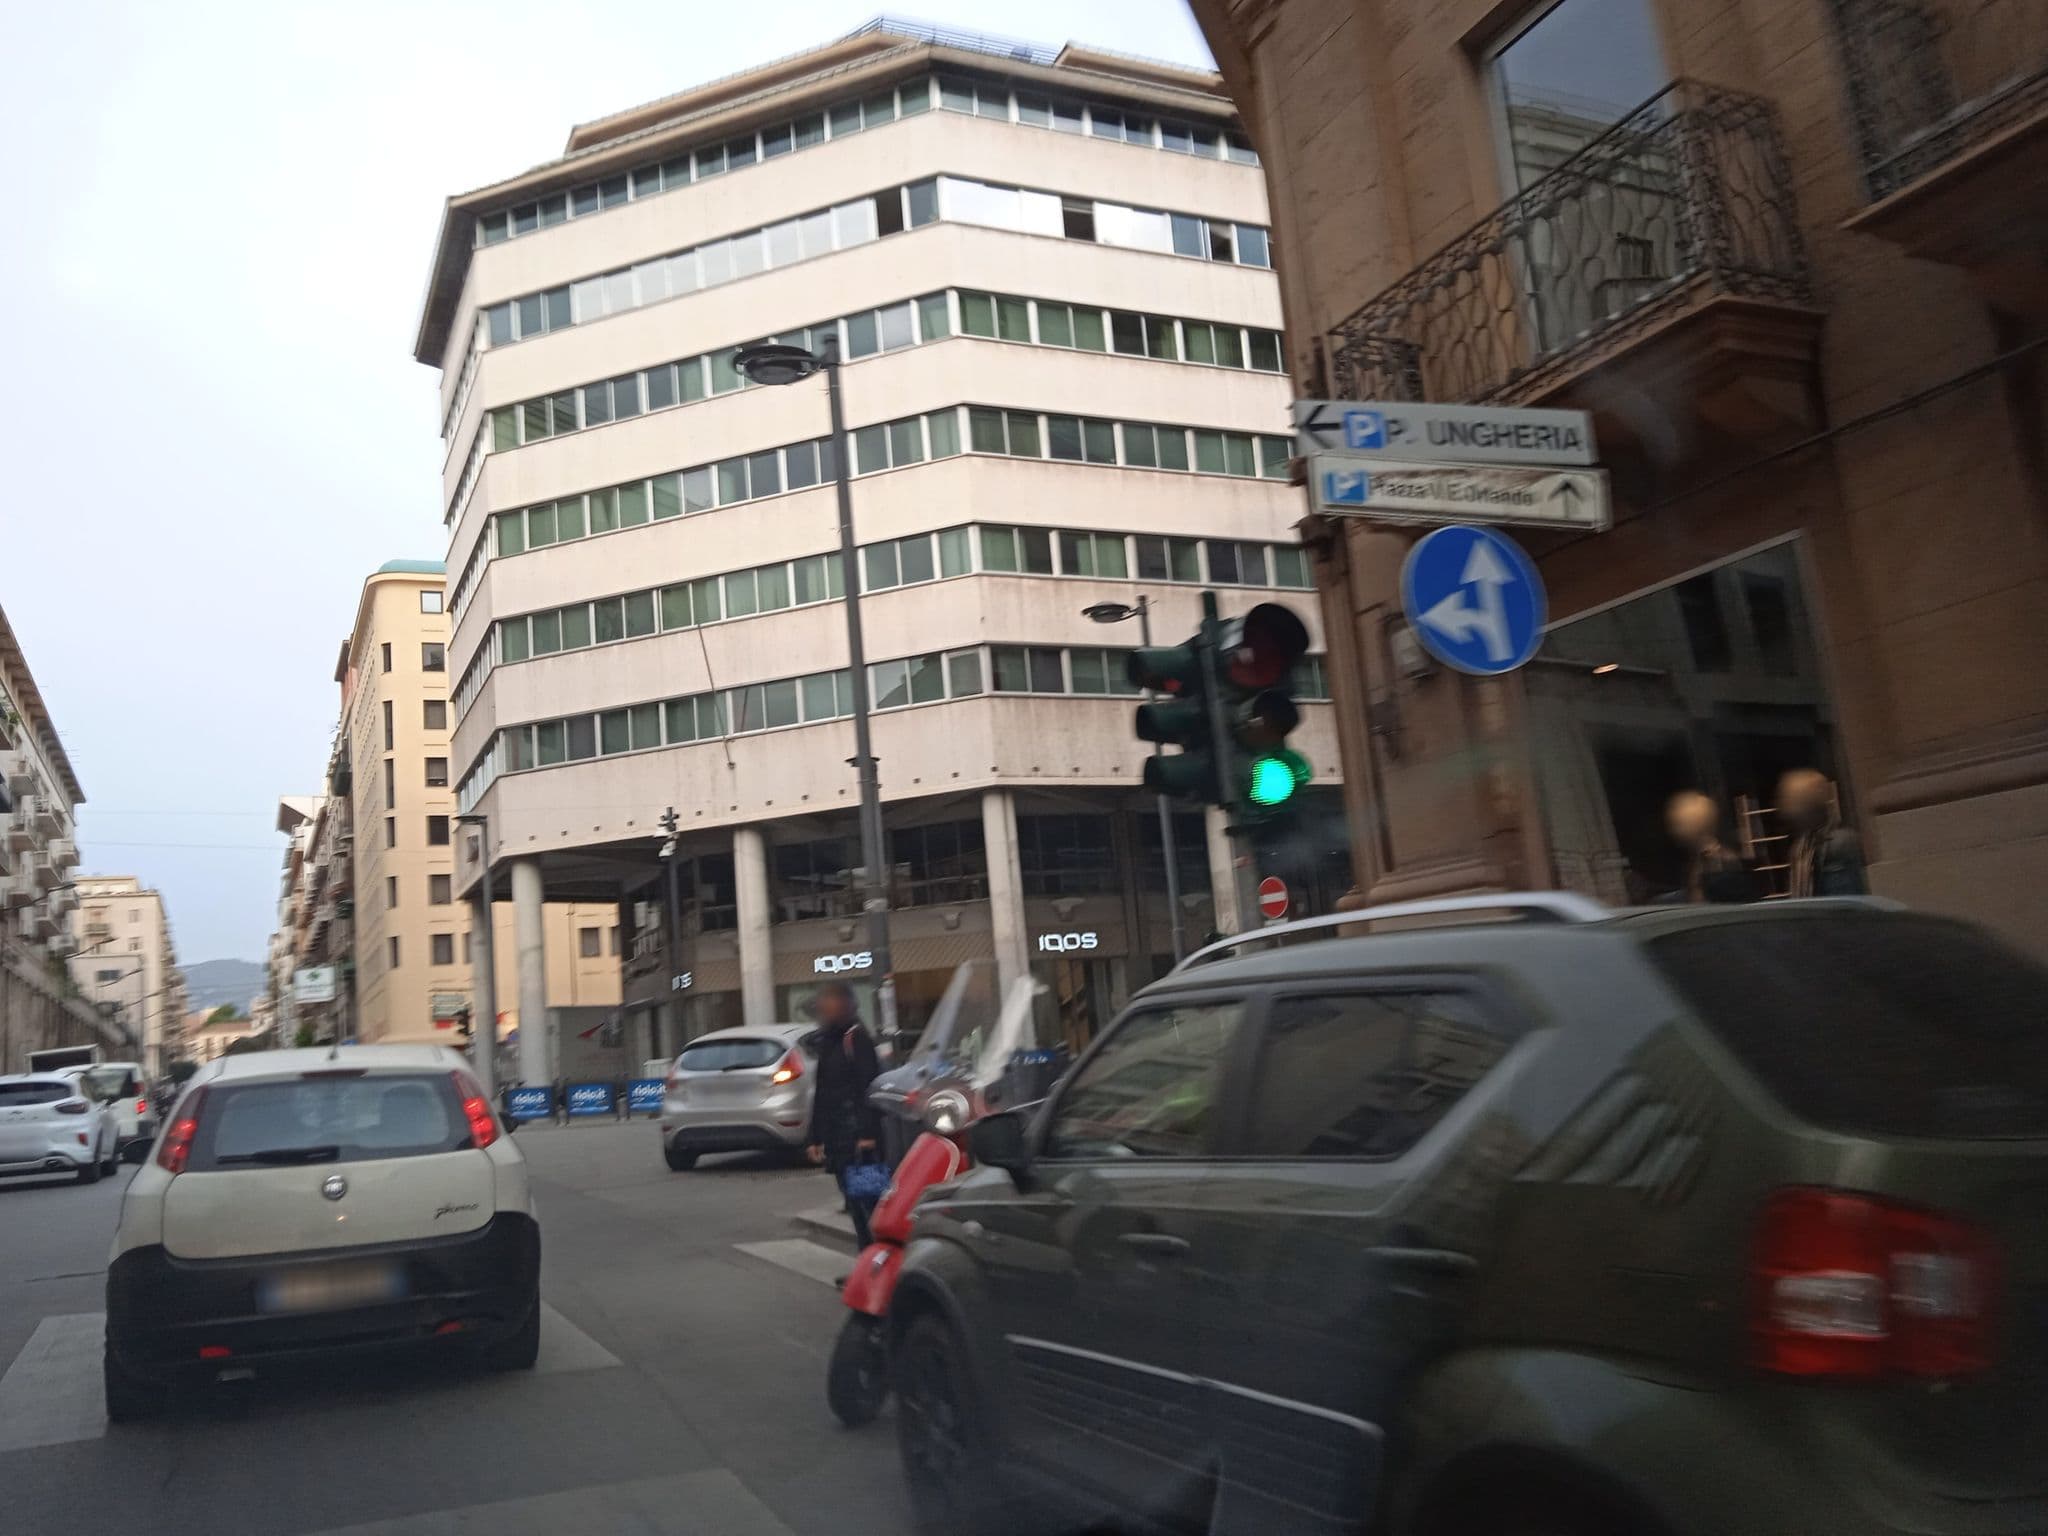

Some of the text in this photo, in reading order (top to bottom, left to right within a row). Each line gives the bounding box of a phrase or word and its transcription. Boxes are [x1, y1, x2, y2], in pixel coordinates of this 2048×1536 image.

[1426, 419, 1583, 451] UNGHERIA
[1038, 932, 1098, 952] IQOS
[814, 951, 873, 974] IQOS
